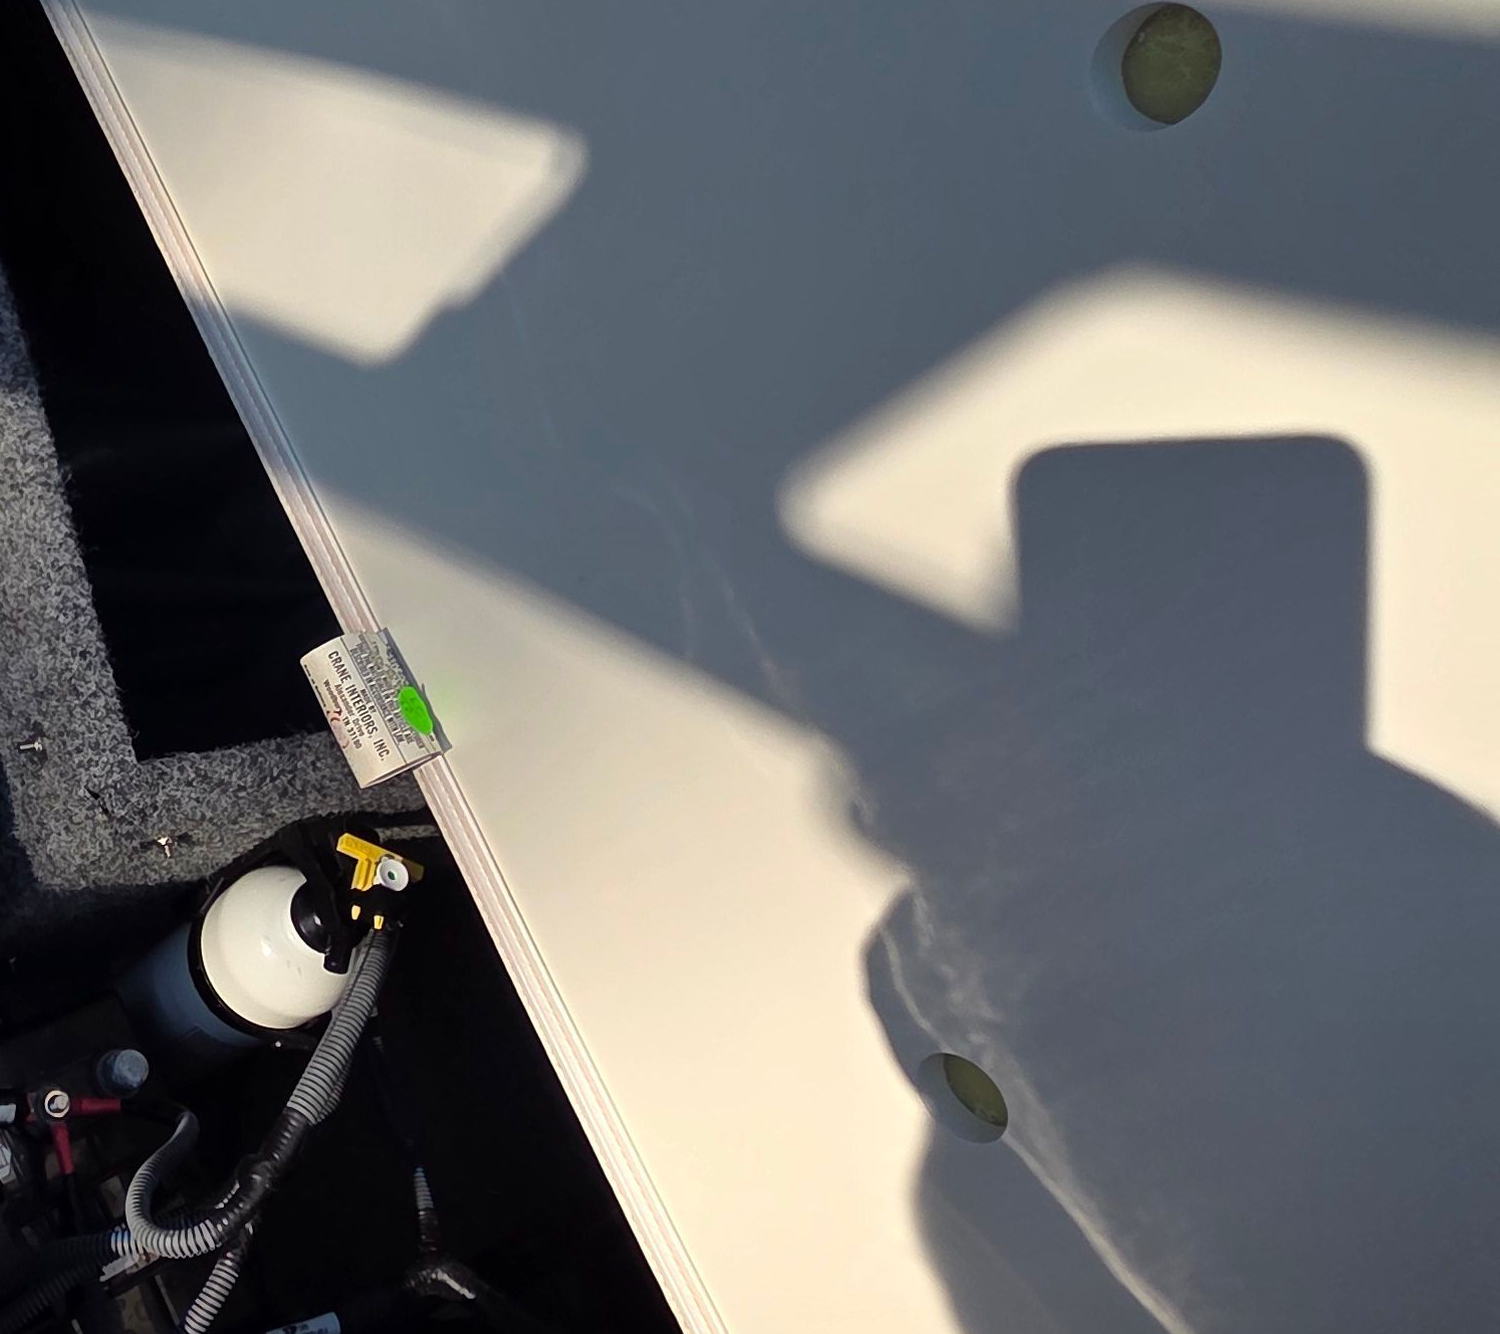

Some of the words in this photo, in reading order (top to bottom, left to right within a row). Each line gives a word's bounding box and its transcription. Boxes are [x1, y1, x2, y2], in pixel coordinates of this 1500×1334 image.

[327, 649, 352, 684] CRANE
[343, 683, 380, 738] INTERIORS,
[372, 737, 391, 761] INC.
[333, 682, 356, 717] Alexander
[351, 717, 366, 737] Drive
[341, 715, 351, 726] TN
